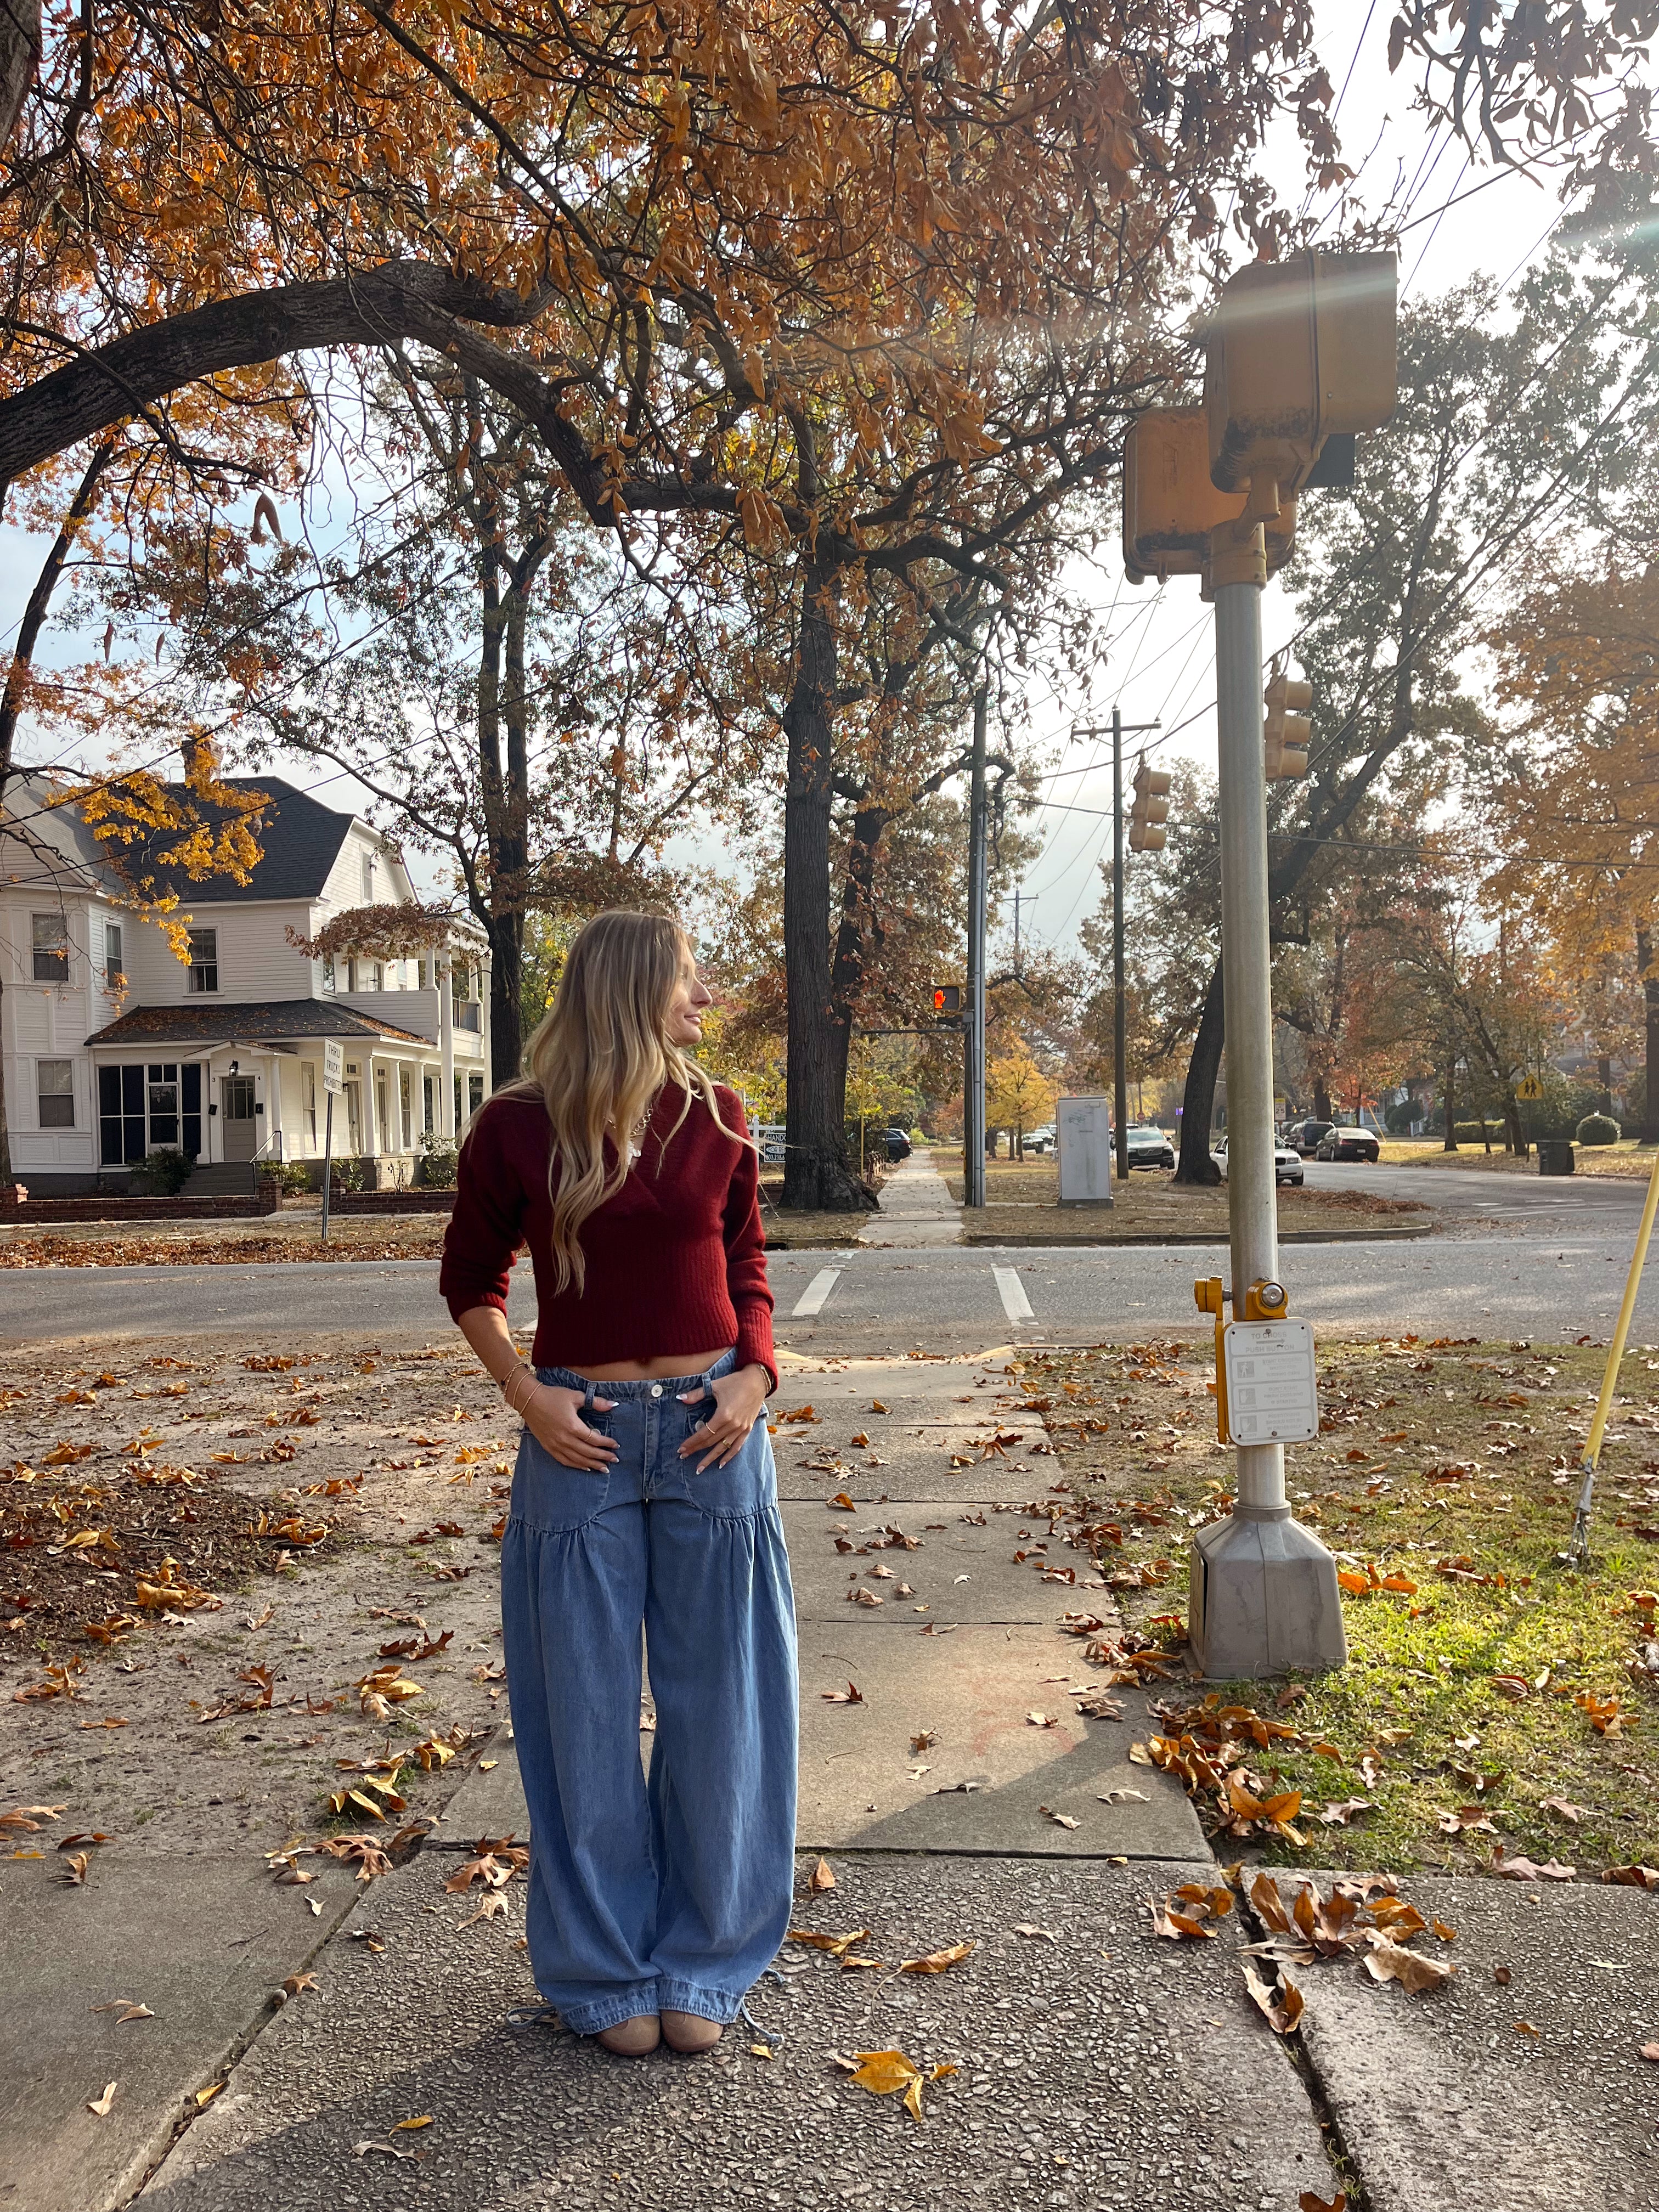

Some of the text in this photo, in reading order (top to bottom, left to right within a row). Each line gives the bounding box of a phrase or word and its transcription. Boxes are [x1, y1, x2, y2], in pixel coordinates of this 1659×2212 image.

[329, 1044, 340, 1058] THRU
[327, 1059, 340, 1074] TRUCKS
[324, 1074, 342, 1091] PROHIBITED
